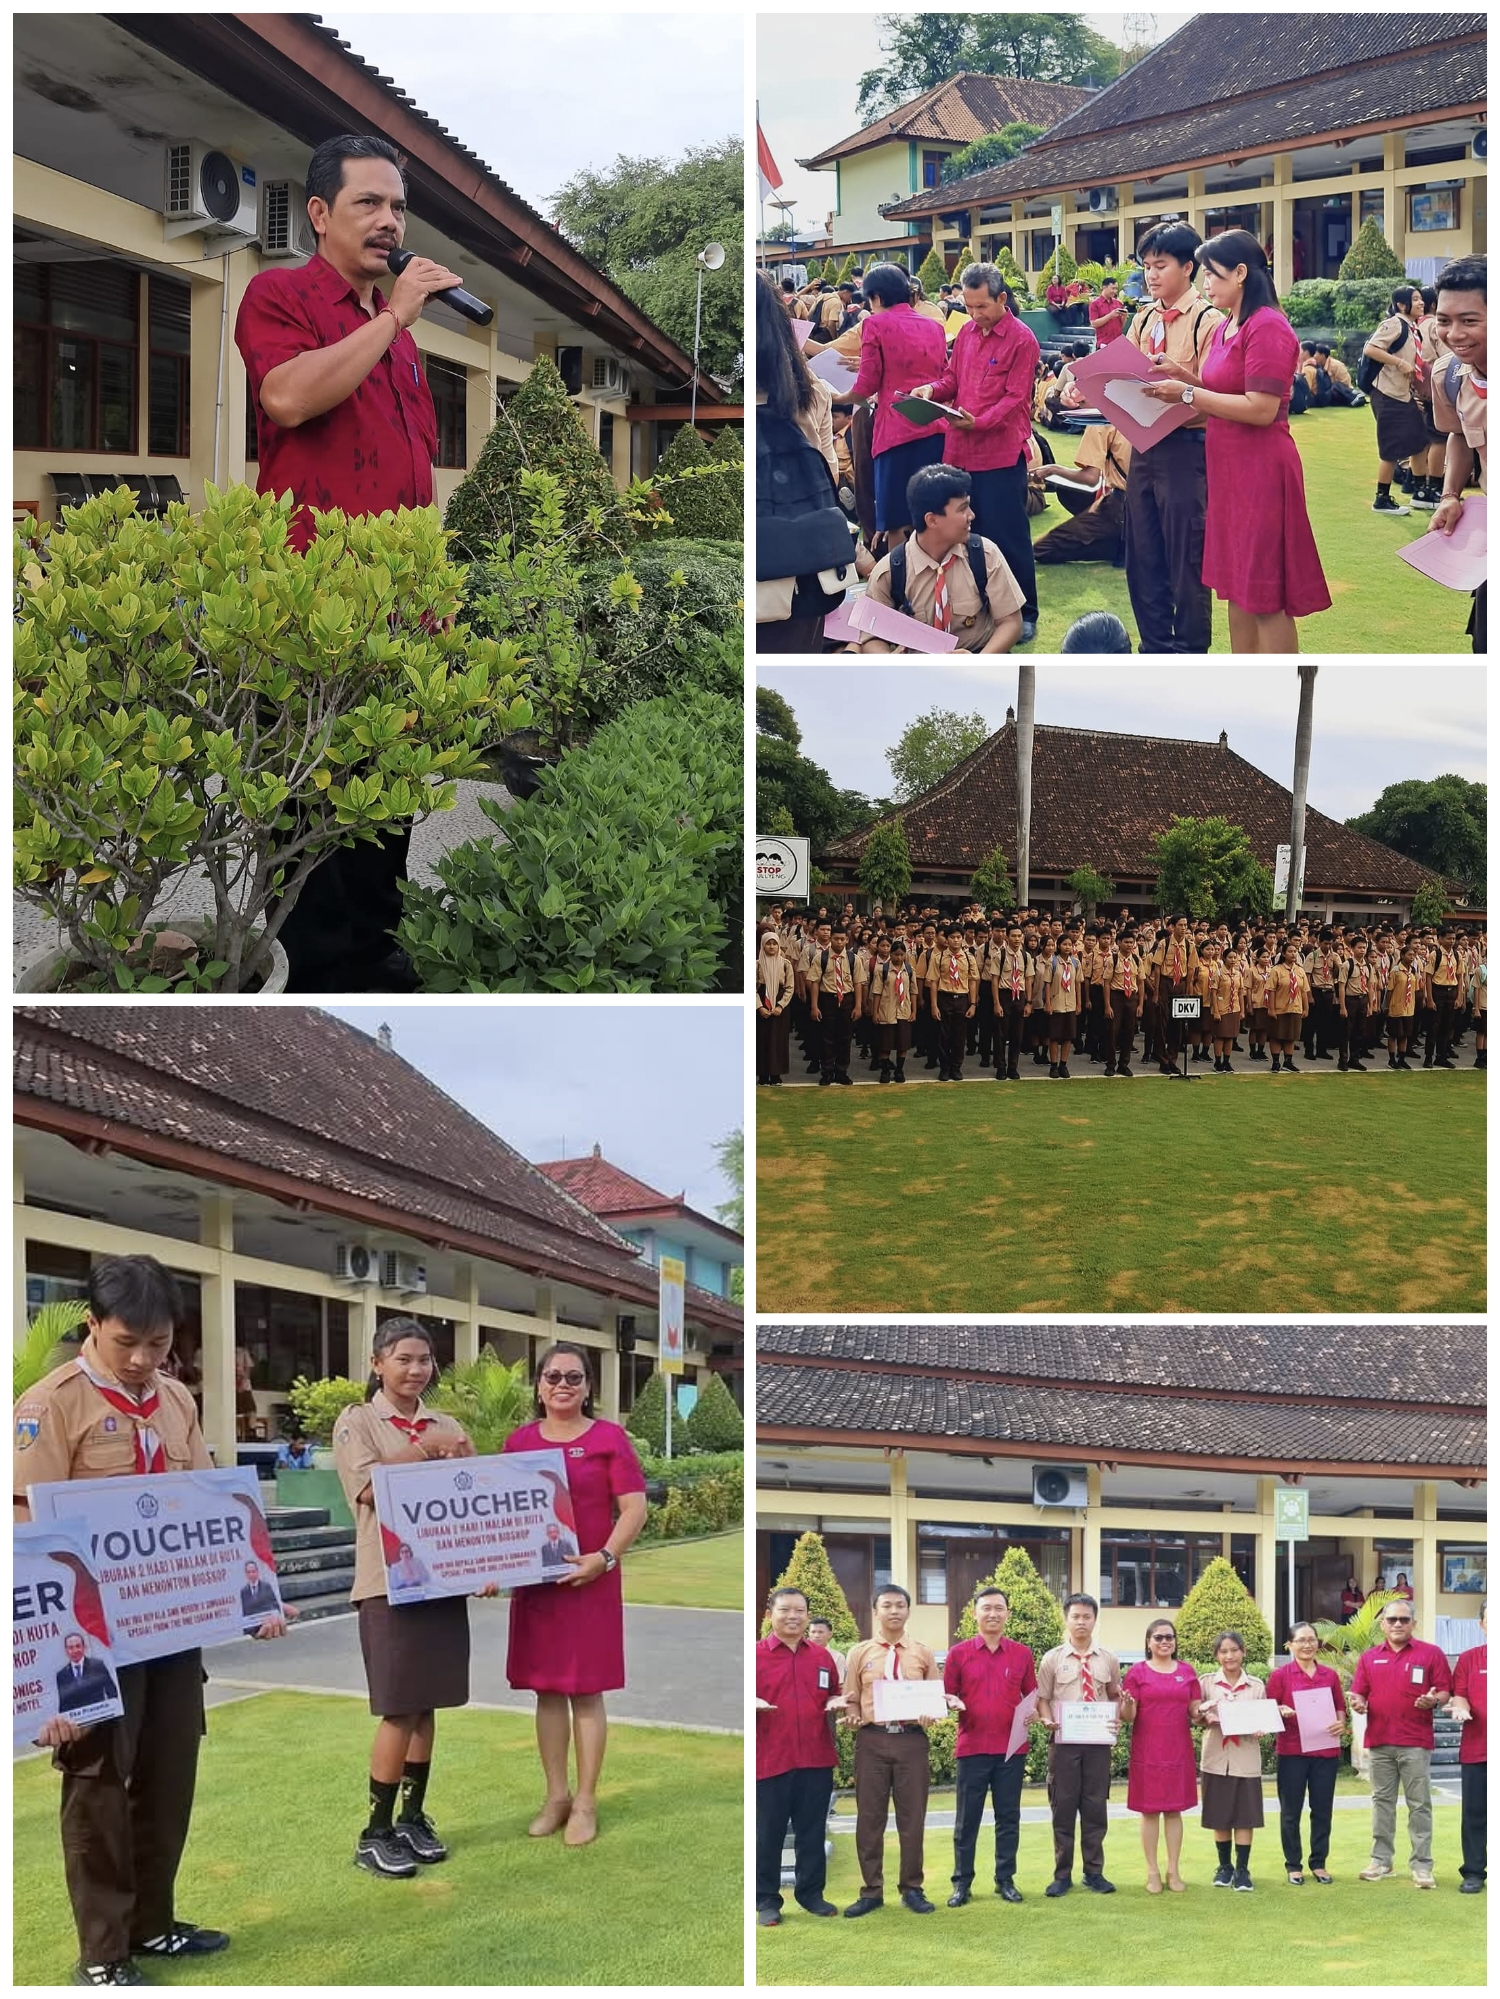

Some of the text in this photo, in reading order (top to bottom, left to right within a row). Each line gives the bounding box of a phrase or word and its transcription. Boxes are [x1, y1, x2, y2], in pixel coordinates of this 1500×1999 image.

[757, 866, 781, 874] STOP
[1178, 1003, 1195, 1013] DKV
[401, 1488, 549, 1524] VOUCHER
[485, 1517, 513, 1530] MALAM
[454, 1533, 496, 1548] MENONTON
[100, 1565, 137, 1583] IBURAN
[175, 1554, 208, 1571] MALAM
[119, 1584, 140, 1600] DAN
[141, 1576, 190, 1596] MENONTON
[26, 1621, 60, 1643] KUTA
